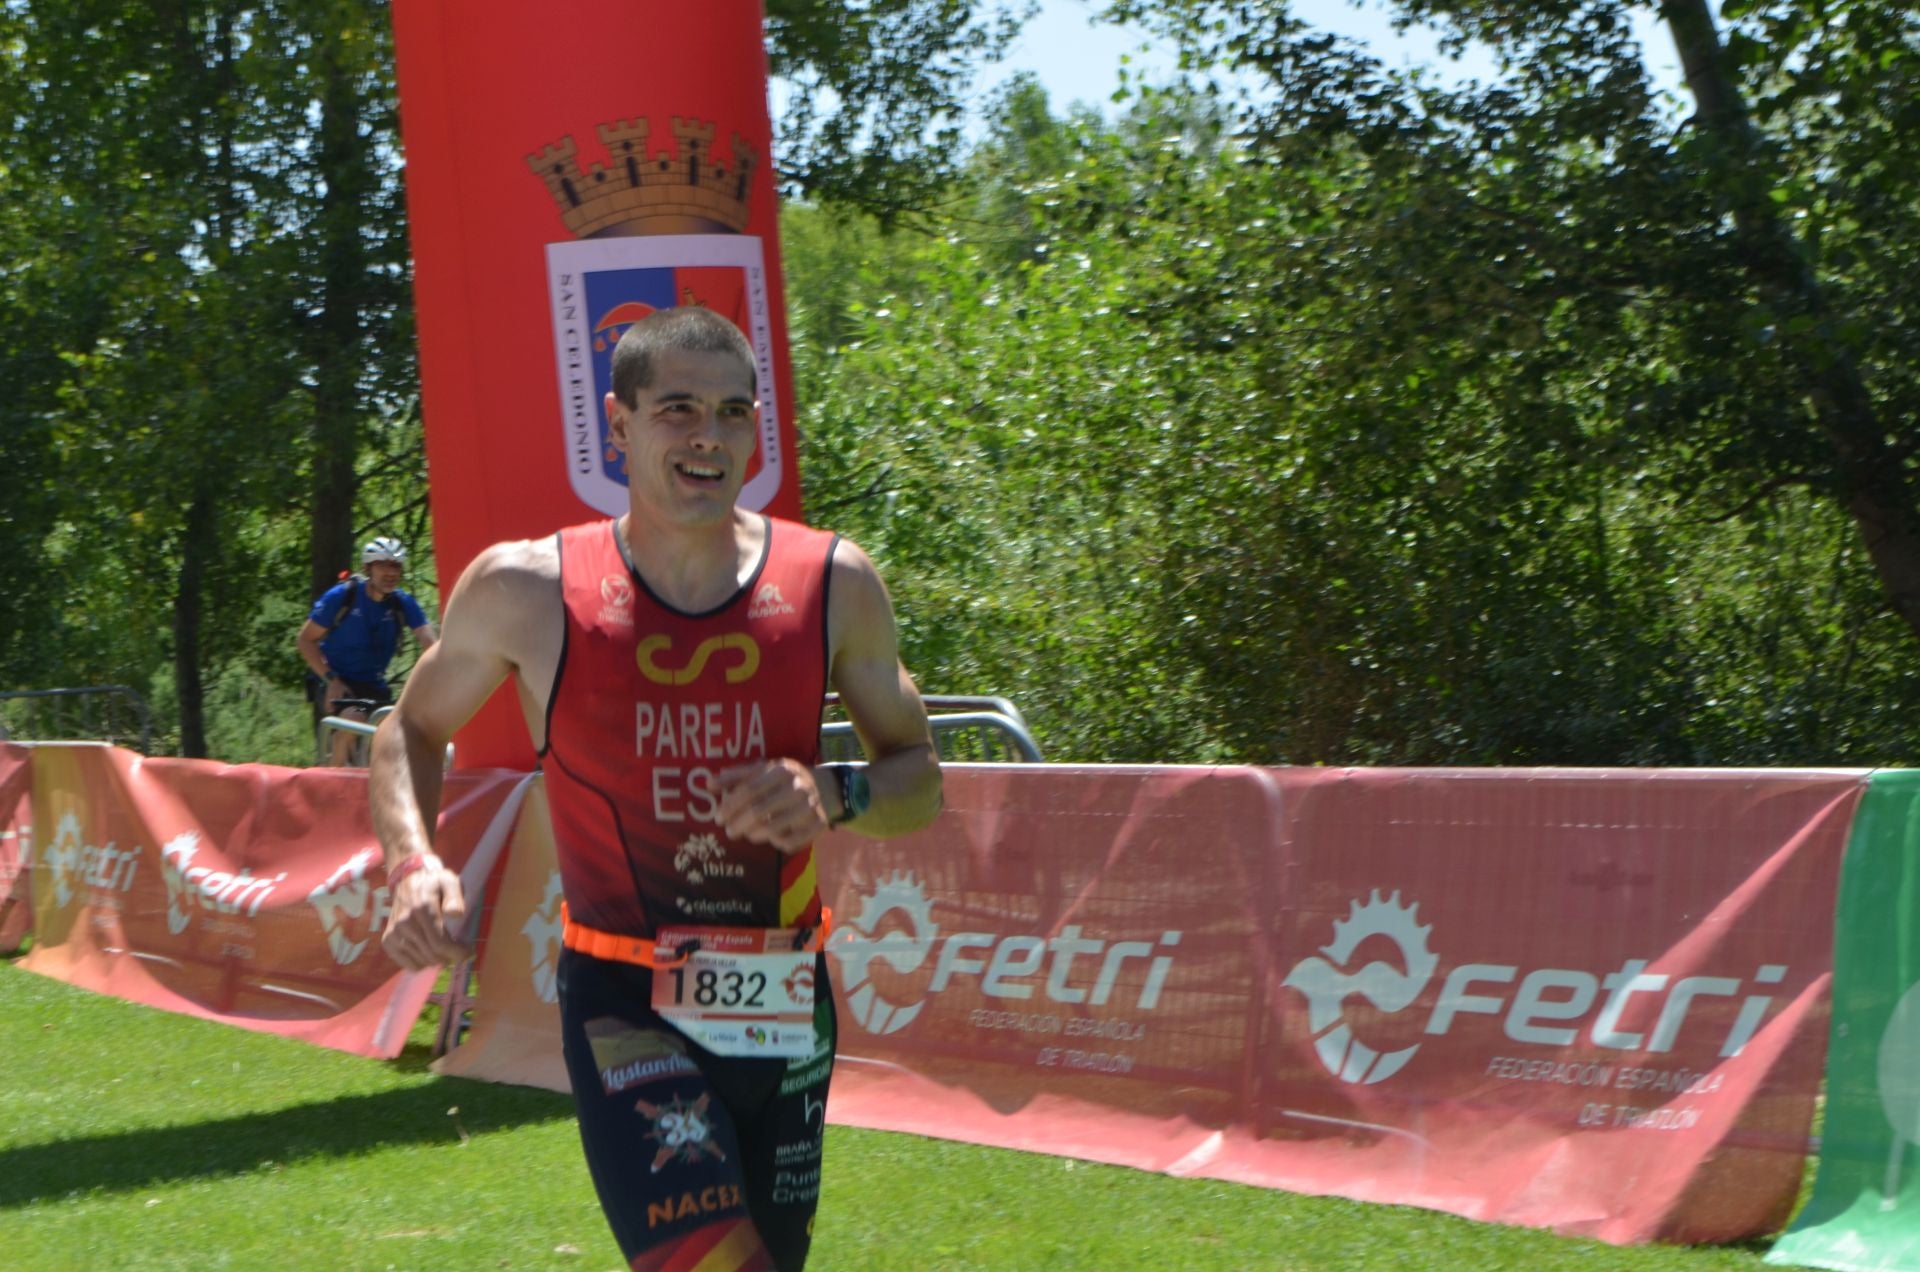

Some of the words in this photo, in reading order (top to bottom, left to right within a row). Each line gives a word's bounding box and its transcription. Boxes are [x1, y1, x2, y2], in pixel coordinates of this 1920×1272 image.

[560, 273, 578, 321] SAN
[635, 701, 767, 759] PAREJA
[652, 766, 724, 822] ES
[668, 967, 767, 1008] 1832
[1486, 1056, 1614, 1087] FEDERACIÓN
[1615, 1066, 1726, 1095] ESPAÑOLA
[1578, 1102, 1611, 1128] DE
